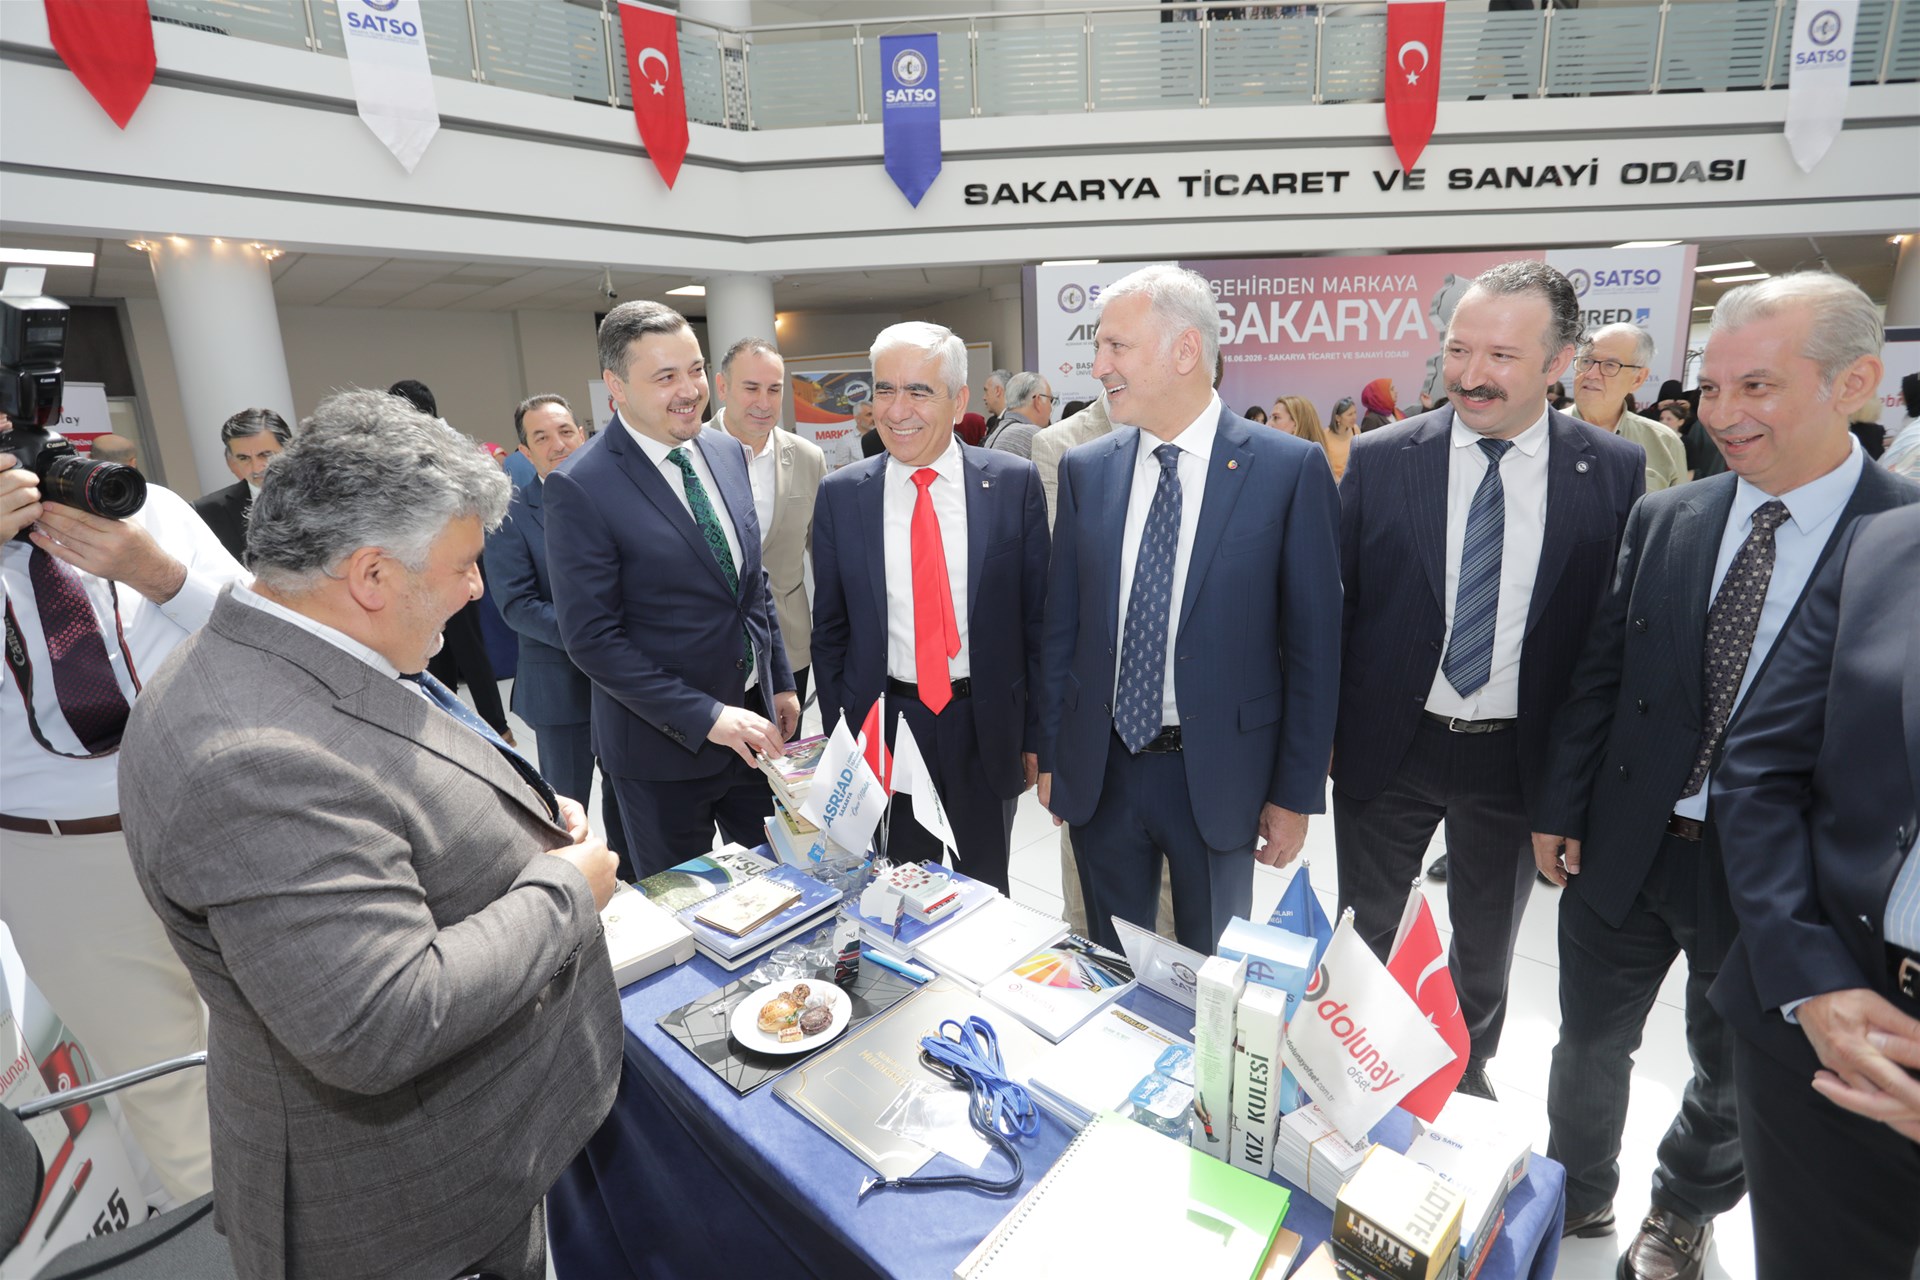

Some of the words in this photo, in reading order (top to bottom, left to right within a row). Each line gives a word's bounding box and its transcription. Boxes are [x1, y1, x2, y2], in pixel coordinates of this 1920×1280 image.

[347, 12, 418, 37] SATSO
[1796, 49, 1846, 65] SATSO
[885, 88, 937, 103] SATSO
[964, 177, 1160, 206] SAKARYA
[1178, 168, 1350, 198] TİCARET
[1372, 168, 1426, 191] VE
[1447, 158, 1599, 190] SANAYİ
[1620, 159, 1747, 185] ODASI
[1209, 275, 1315, 300] ŞEHİRDEN
[1322, 275, 1418, 294] MARKAYA
[1594, 269, 1662, 287] SATSO
[1218, 298, 1429, 345] SAKARYA
[1268, 352, 1306, 362] SAKARYA
[1307, 350, 1341, 360] TİCARET
[1343, 351, 1353, 360] VE
[1355, 350, 1384, 360] SANAYİ
[1385, 350, 1410, 359] ODASI
[46, 441, 67, 449] Canon
[822, 768, 854, 828] ASRİAD
[838, 792, 853, 817] SAKARYA
[1169, 977, 1196, 994] SAT
[1317, 1000, 1401, 1093] dolunay
[1246, 1051, 1269, 1125] KULESİ
[1346, 1066, 1372, 1093] ofset
[1245, 1131, 1265, 1166] KIZ
[1441, 1137, 1463, 1150] SAYIN
[86, 1187, 130, 1242] 55
[1346, 1211, 1414, 1267] LOTTE
